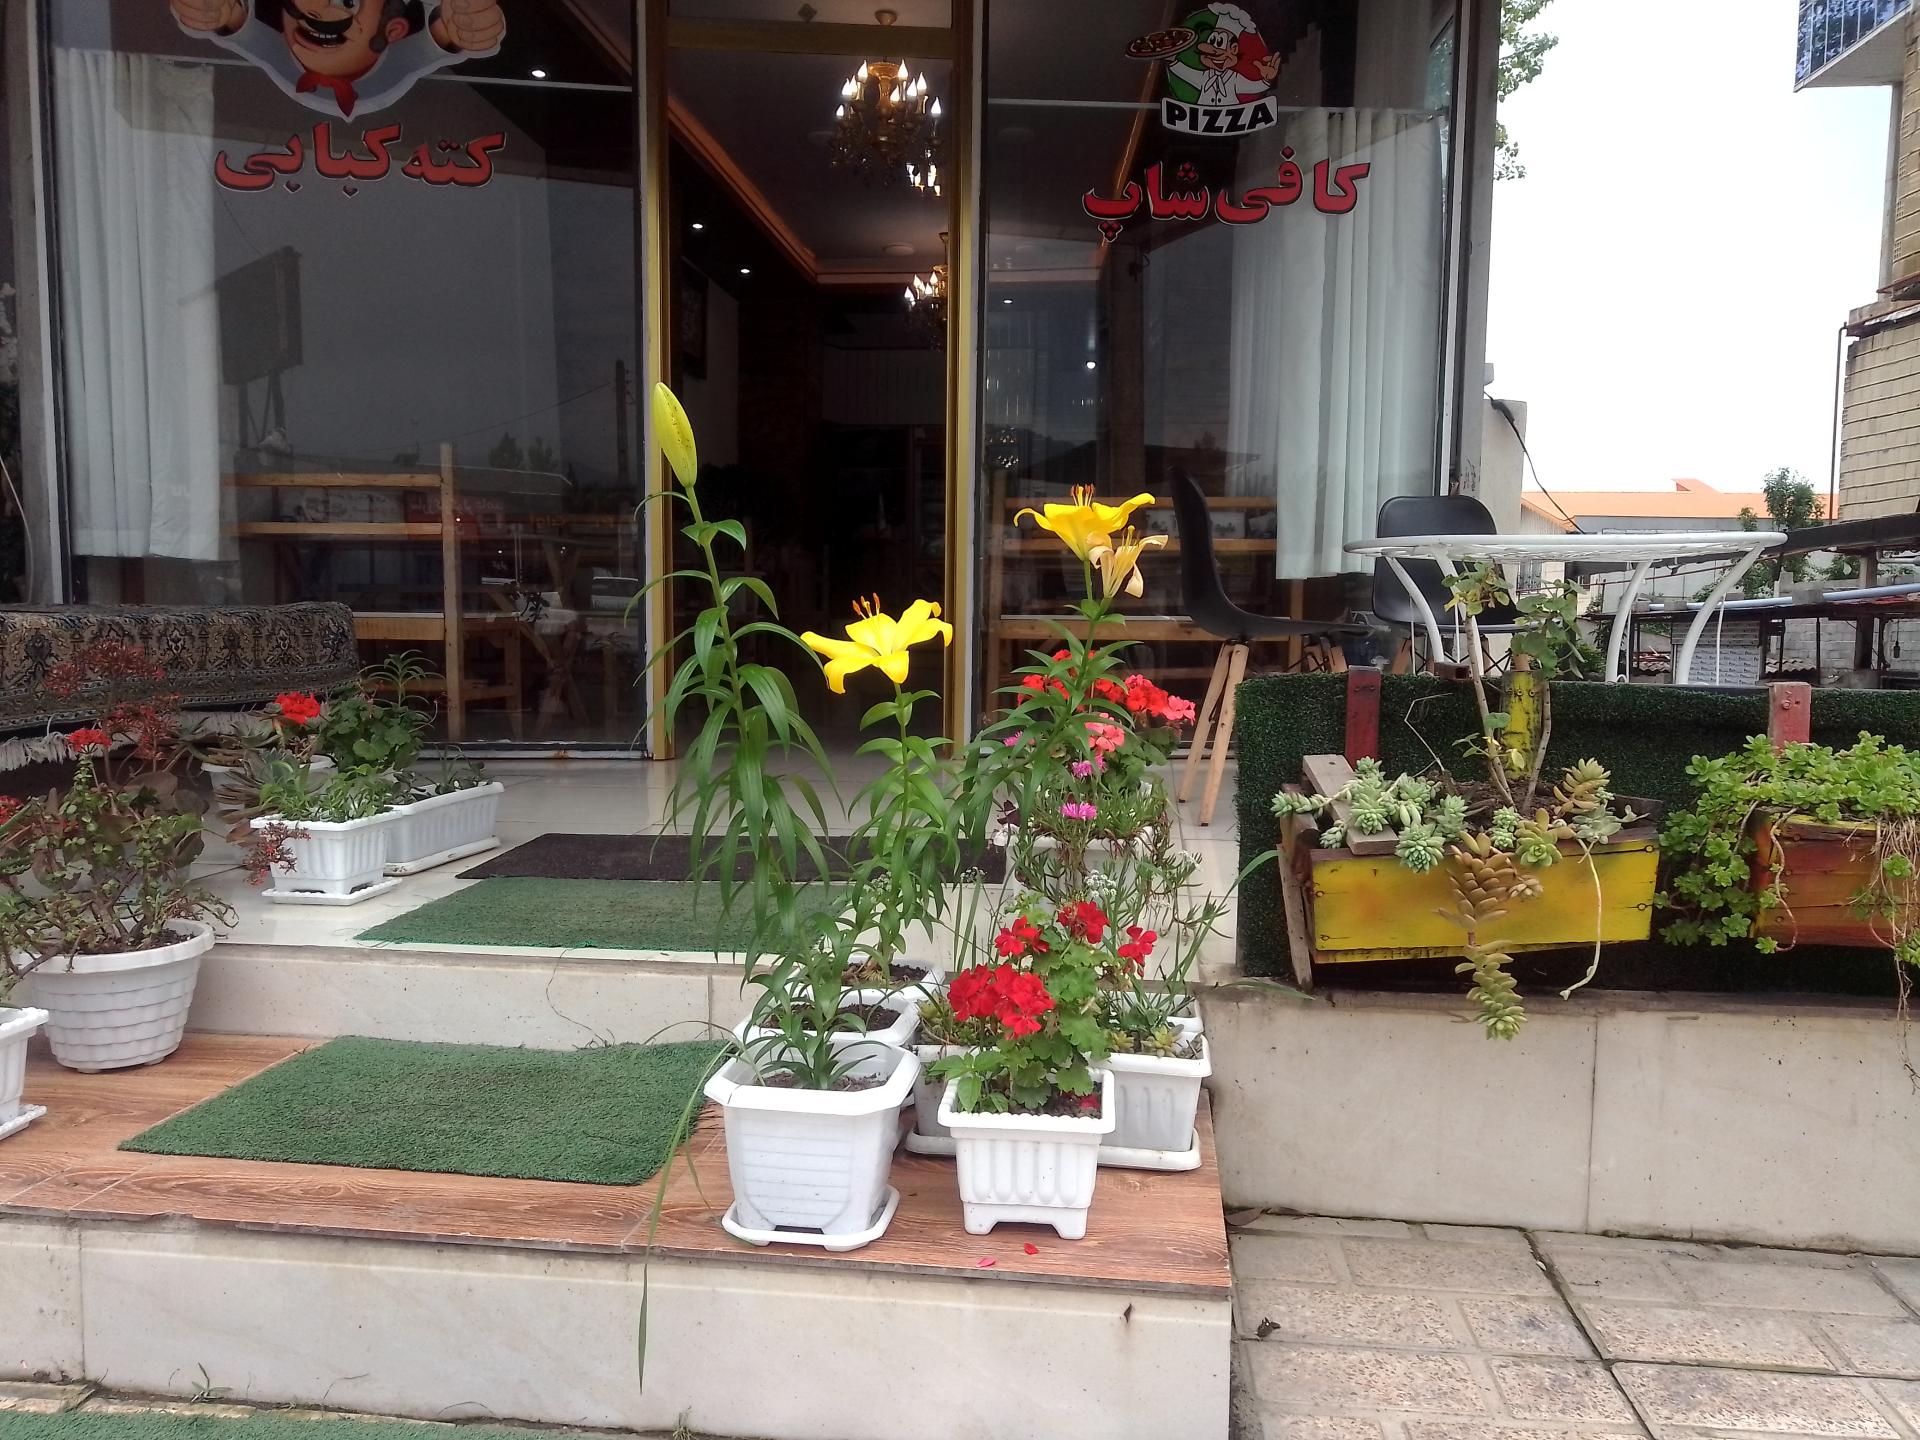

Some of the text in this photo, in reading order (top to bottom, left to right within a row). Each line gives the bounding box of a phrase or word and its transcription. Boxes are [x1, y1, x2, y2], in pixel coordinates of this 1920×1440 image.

[1166, 102, 1275, 133] PIZZA
[214, 121, 506, 198] کته کبابی
[1082, 146, 1371, 243] کافی شاپ
